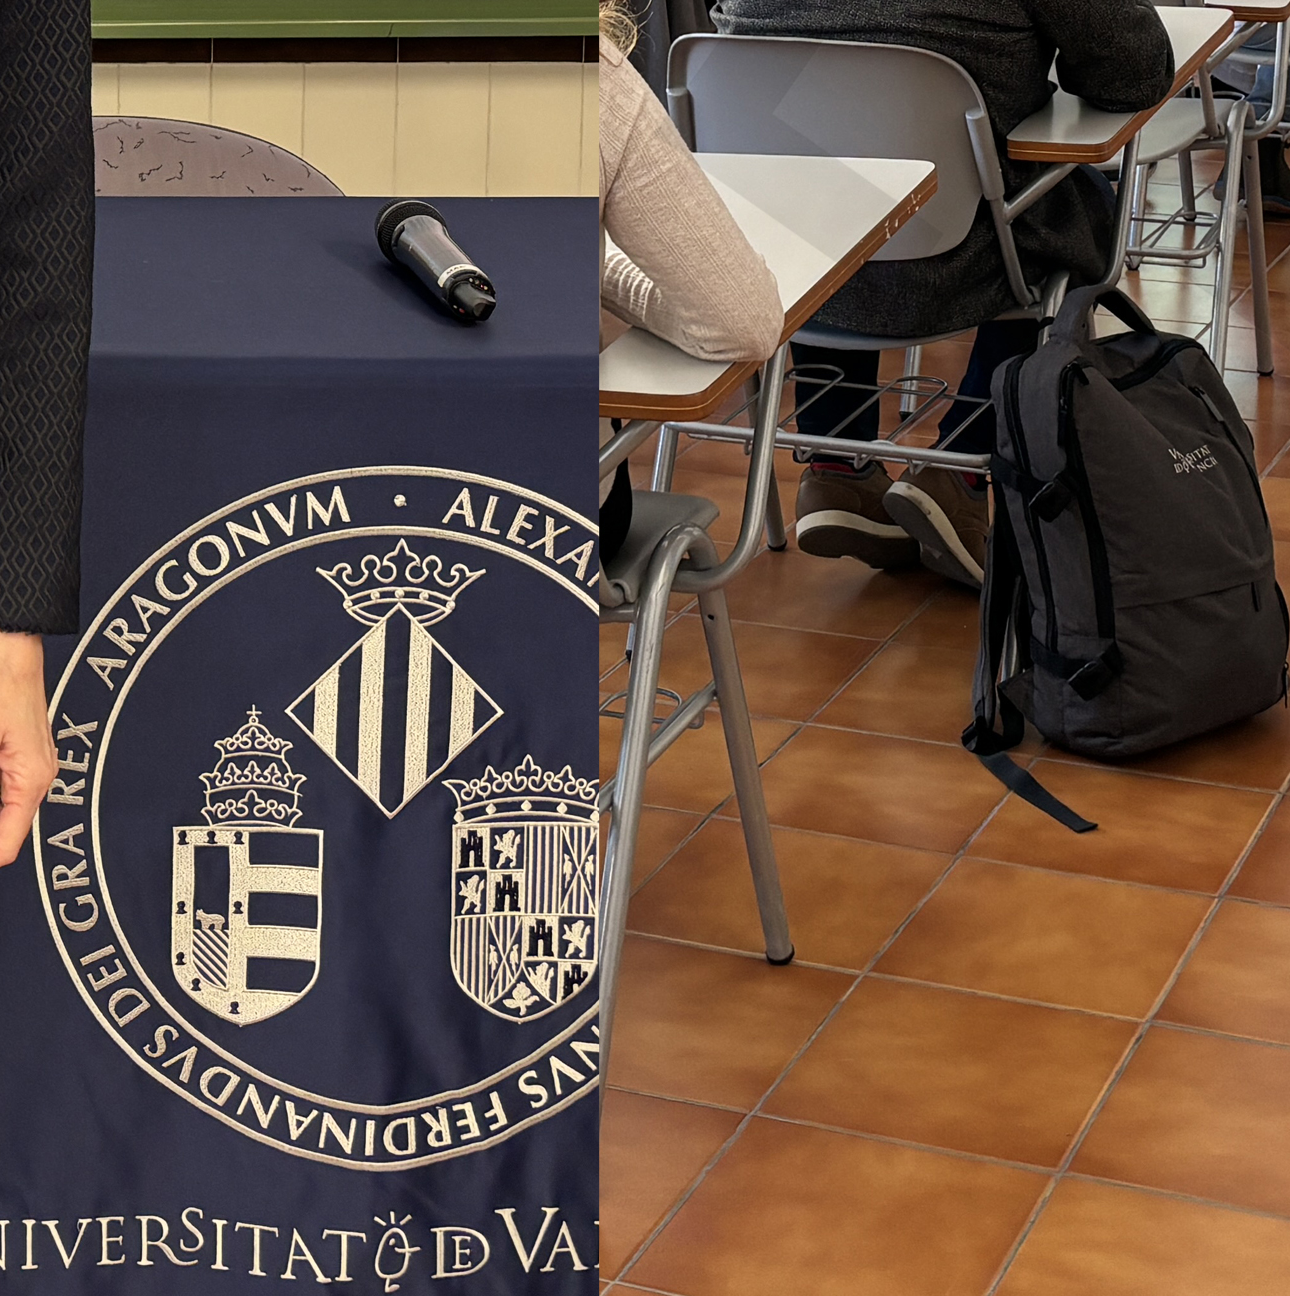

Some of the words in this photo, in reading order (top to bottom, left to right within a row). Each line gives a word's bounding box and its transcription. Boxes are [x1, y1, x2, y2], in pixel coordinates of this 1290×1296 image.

[86, 485, 352, 692] ARAGONVM
[47, 712, 99, 806] REX
[47, 822, 100, 932] GRA
[79, 943, 151, 1028] DEI
[142, 1023, 510, 1157] FERDINANDVS
[494, 1205, 599, 1274] VA
